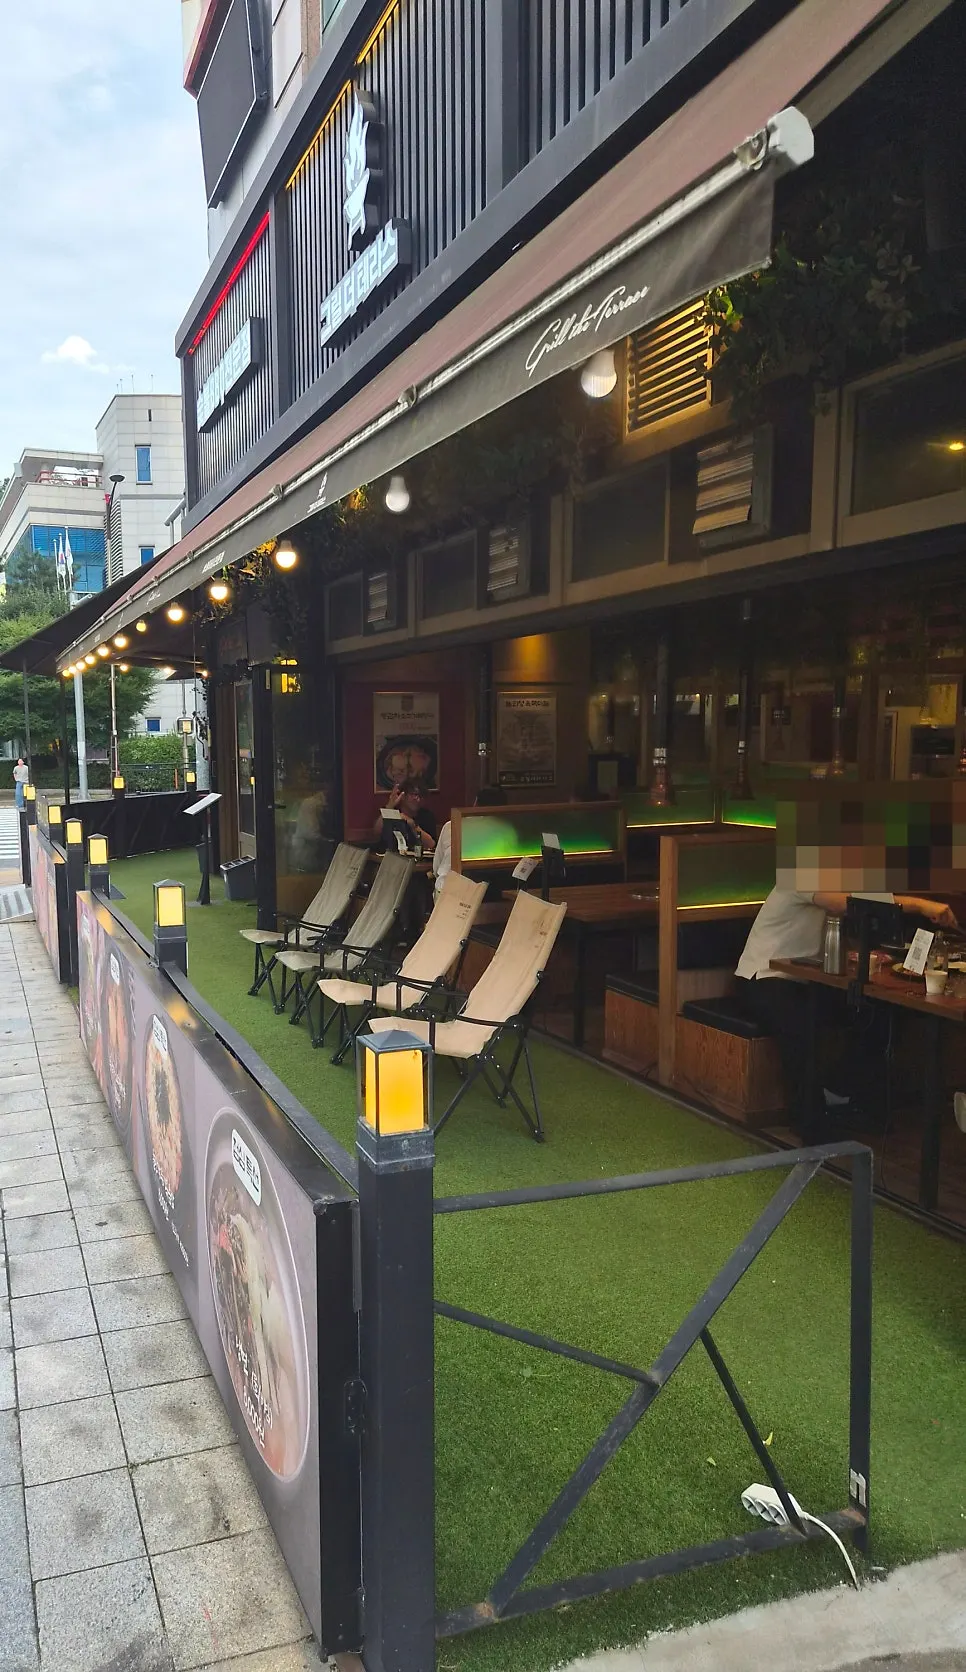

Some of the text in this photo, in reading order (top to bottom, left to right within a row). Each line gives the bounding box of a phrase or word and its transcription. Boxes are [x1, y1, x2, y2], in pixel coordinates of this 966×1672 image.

[321, 227, 396, 342] 그릴 더 테라스
[525, 285, 650, 377] Grill the Terrace
[233, 1136, 259, 1192] 점심특선
